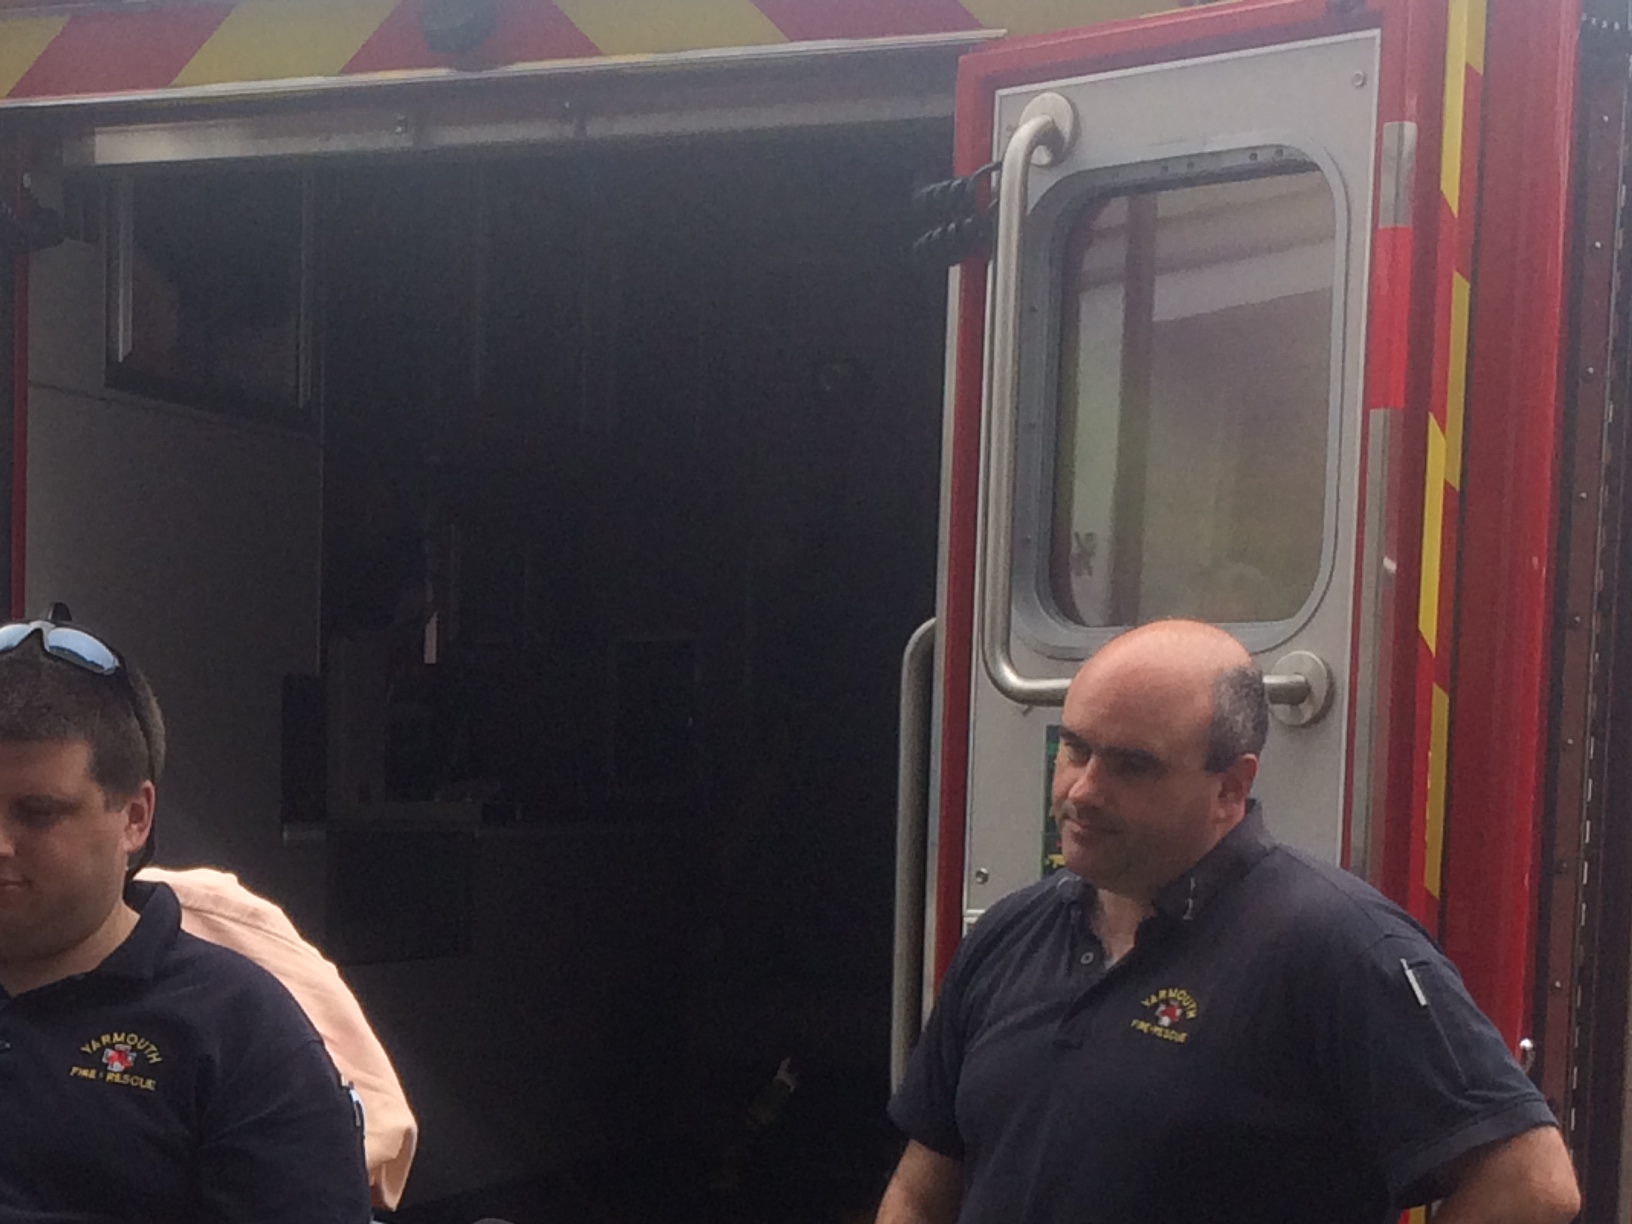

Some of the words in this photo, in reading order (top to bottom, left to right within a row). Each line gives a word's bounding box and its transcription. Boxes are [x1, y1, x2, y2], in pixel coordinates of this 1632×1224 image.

[80, 1031, 163, 1065] YARMOUTH
[69, 1065, 97, 1080] FIRE
[105, 1071, 157, 1091] RESCUE
